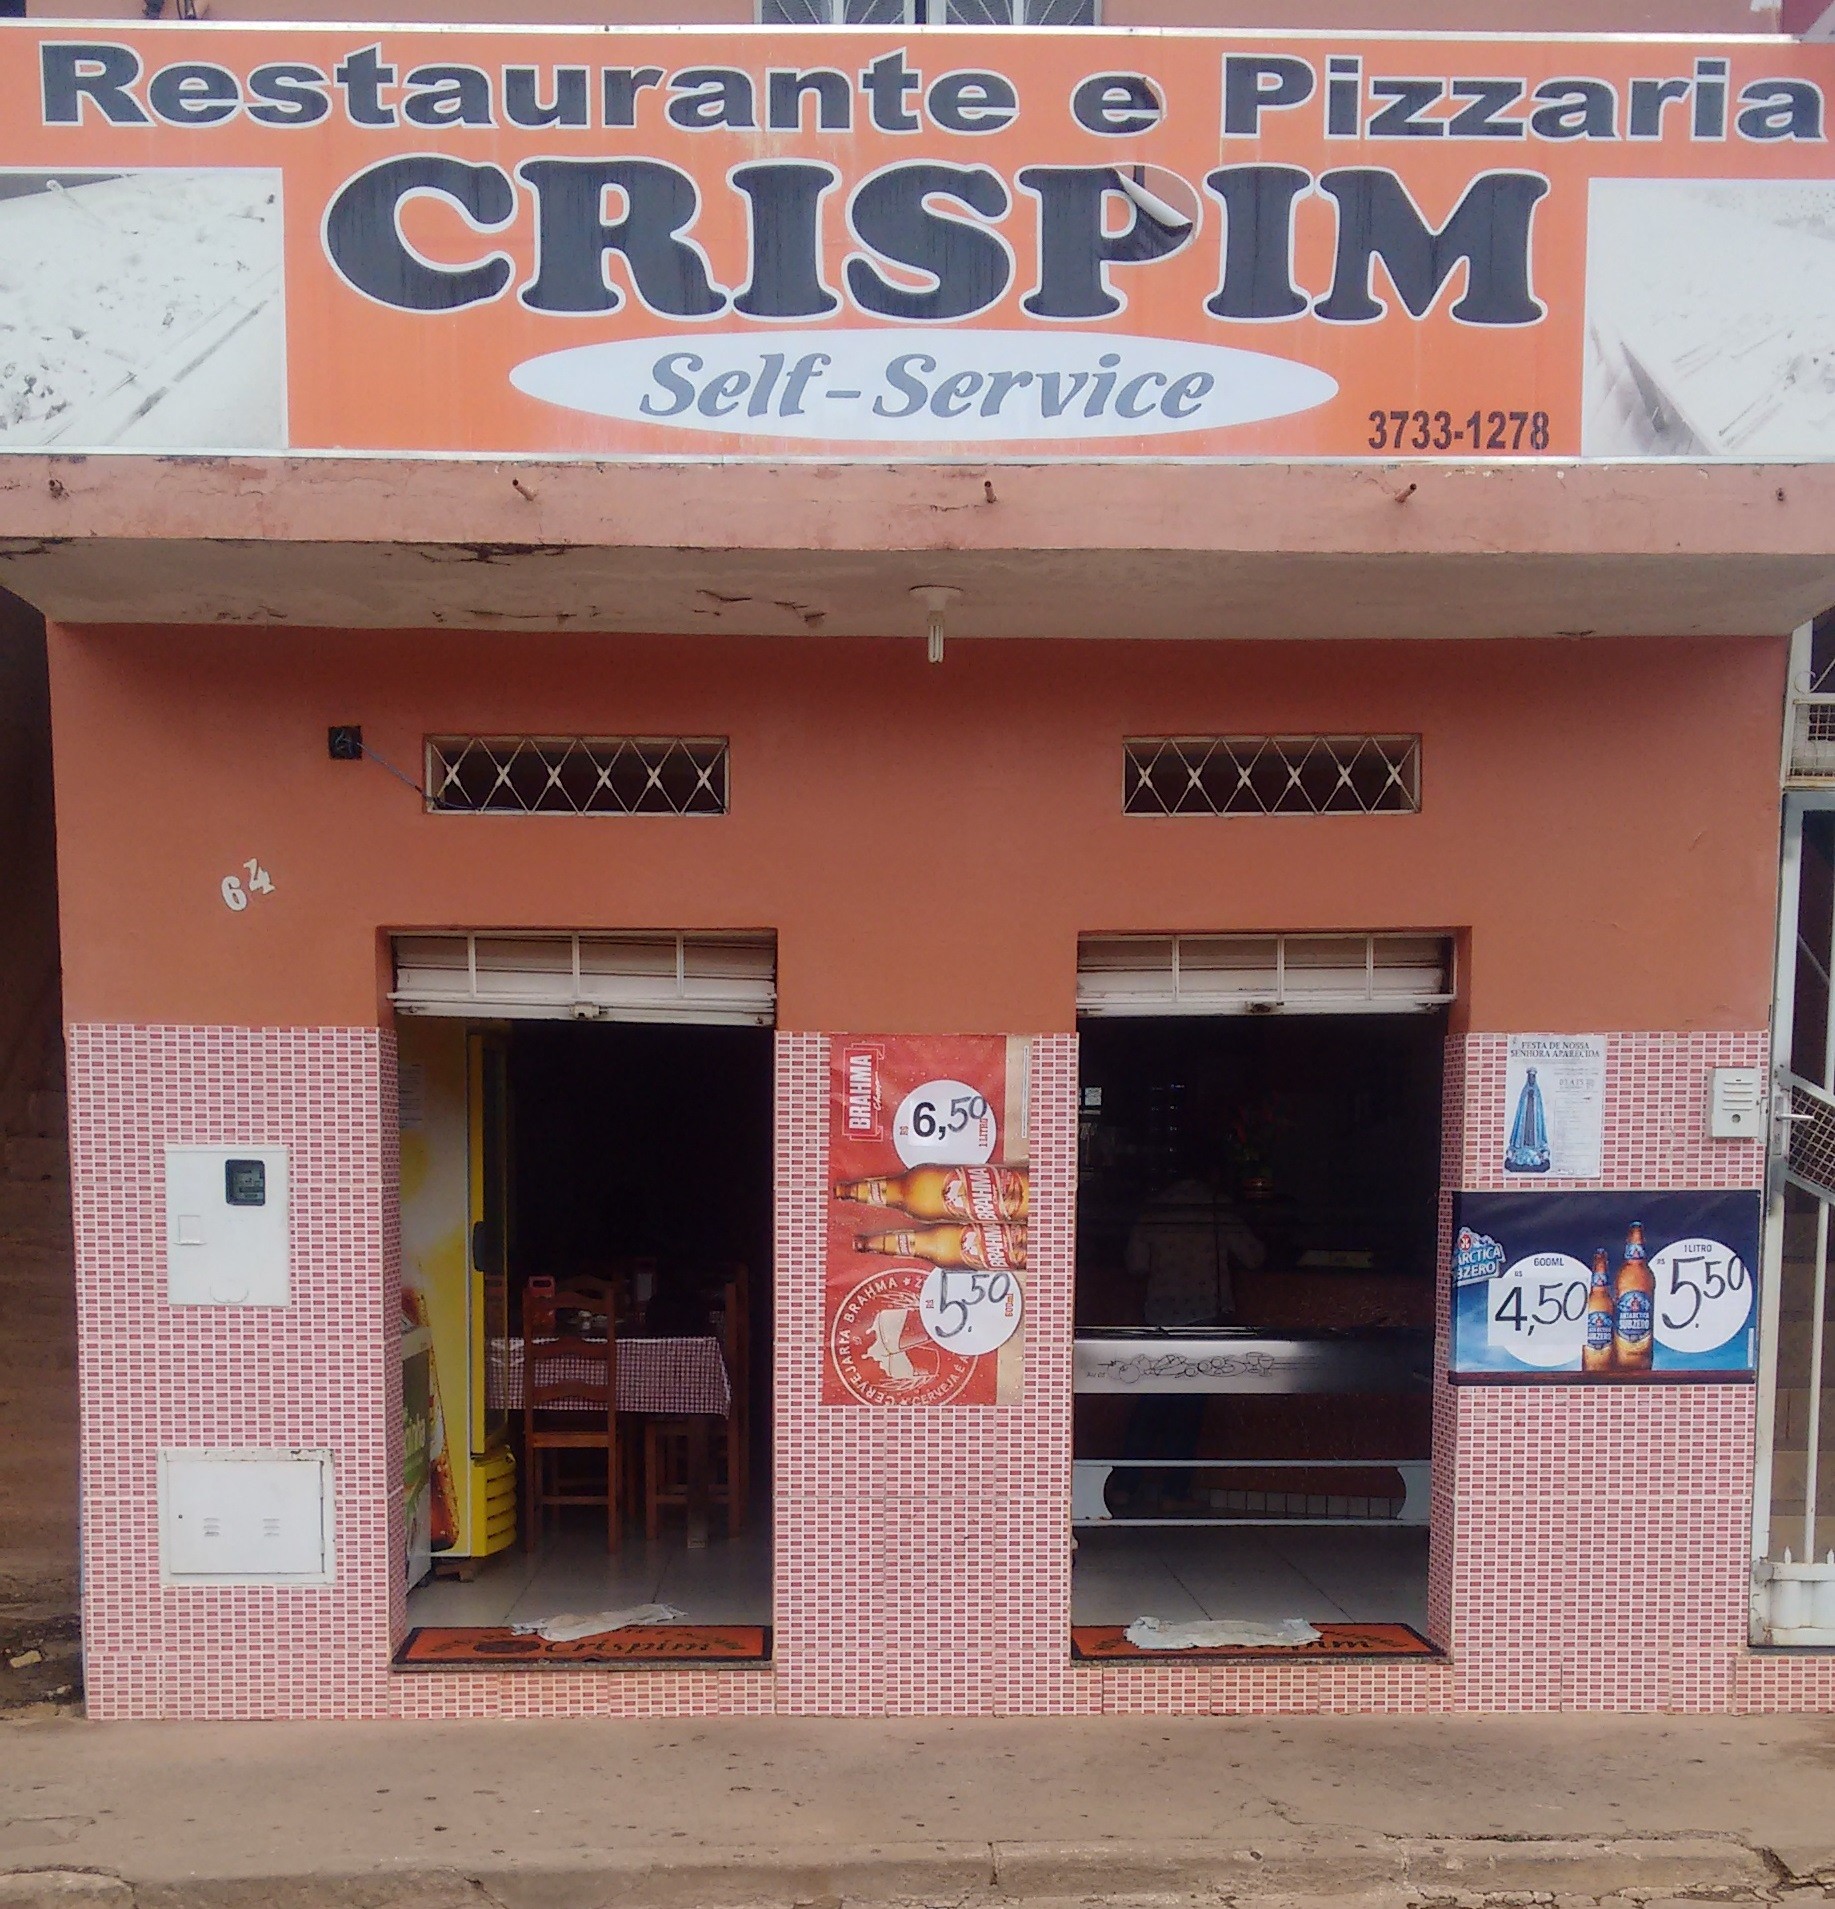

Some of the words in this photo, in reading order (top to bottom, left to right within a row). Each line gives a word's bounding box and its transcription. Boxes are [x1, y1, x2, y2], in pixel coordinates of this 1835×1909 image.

[40, 42, 1019, 135] Restaurante
[1072, 71, 1165, 137] e
[1221, 53, 1825, 143] Pizzaria
[320, 153, 1550, 327] CRISPIM
[639, 352, 1215, 419] Self-Service
[1368, 410, 1550, 450] 3733-1278
[221, 858, 276, 912] 64
[1510, 1049, 1551, 1058] SENHORA
[1551, 1049, 1600, 1058] APARECIDA
[1521, 1041, 1548, 1050] FESTA
[1549, 1041, 1560, 1050] DE
[1562, 1041, 1590, 1050] NOSSA
[848, 1054, 873, 1130] BRAHMA
[912, 1094, 988, 1139] 6,50
[967, 1166, 998, 1222] BRAHMA
[1533, 1257, 1565, 1267] 600ML
[847, 1277, 899, 1324] BRAHMA
[1494, 1280, 1589, 1337] 4,50
[839, 1329, 896, 1406] CERVEJARIA
